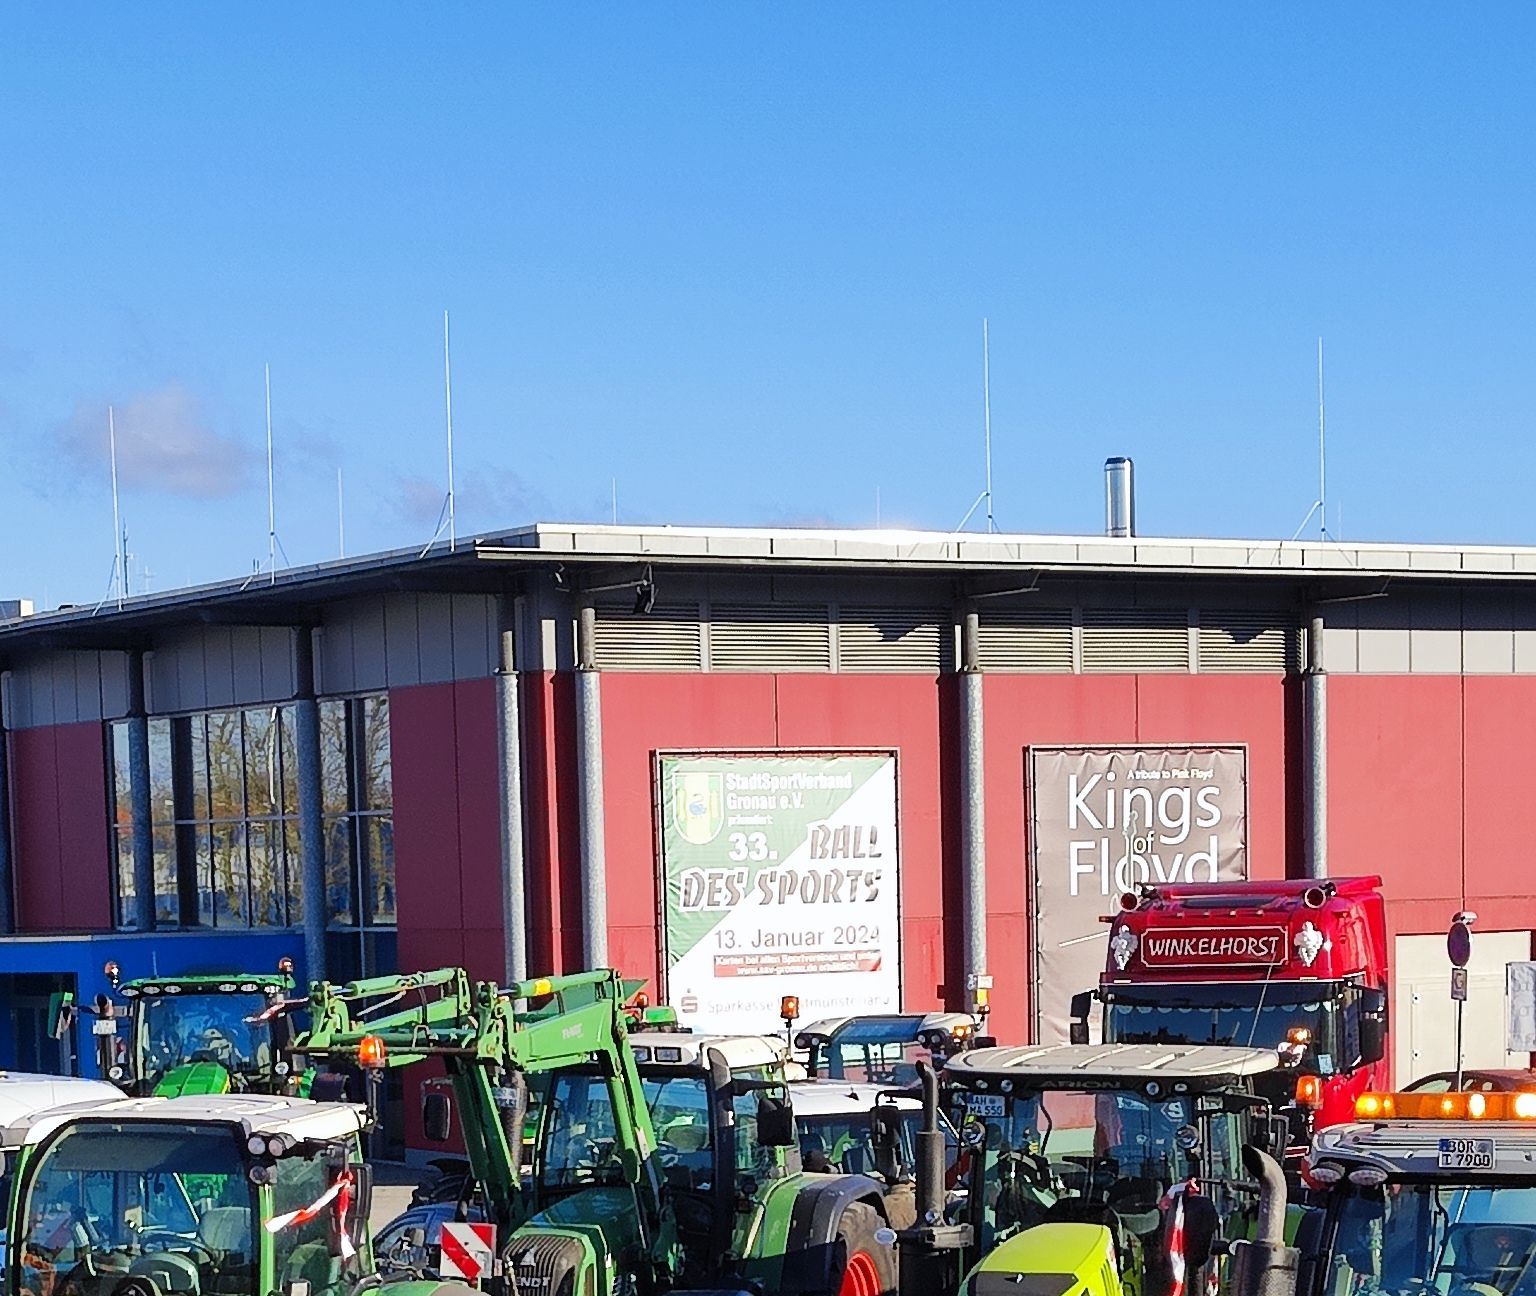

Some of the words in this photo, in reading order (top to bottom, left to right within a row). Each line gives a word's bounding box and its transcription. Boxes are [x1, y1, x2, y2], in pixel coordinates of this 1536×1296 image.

[1162, 770, 1170, 779] to
[1172, 769, 1189, 779] Pink
[1190, 769, 1214, 780] Floyd
[728, 793, 776, 810] Gronau
[780, 792, 805, 809] e.V.
[1068, 771, 1221, 845] Kings
[728, 832, 778, 861] 33.
[810, 824, 882, 860] BALL
[1134, 831, 1156, 854] of
[682, 871, 745, 908] DES
[758, 868, 883, 906] SPORTS
[715, 929, 742, 950] 13.
[751, 927, 825, 949] Januar
[833, 924, 881, 946] 2024
[1148, 935, 1280, 957] WINKELHORST
[1040, 1080, 1121, 1089] ARION
